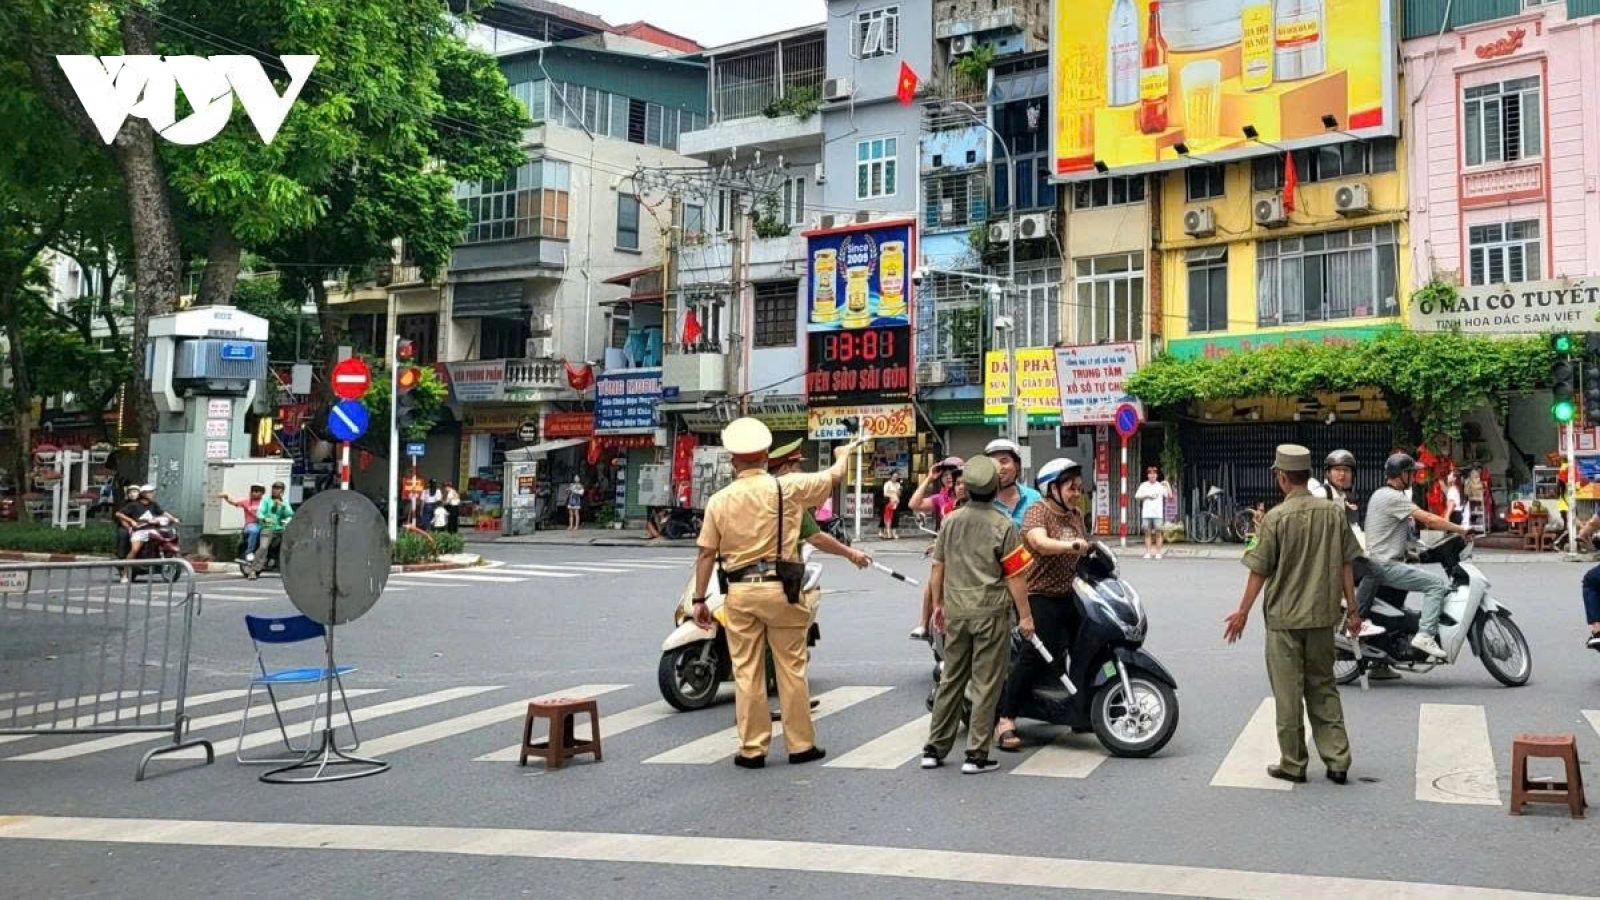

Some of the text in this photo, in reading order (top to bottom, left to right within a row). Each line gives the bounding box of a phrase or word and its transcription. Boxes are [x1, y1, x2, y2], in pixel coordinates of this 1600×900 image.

[847, 243, 869, 252] Since
[847, 253, 869, 264] 2009
[1440, 296, 1480, 314] MAI
[1486, 289, 1515, 310] CÔ
[1522, 281, 1600, 308] TUYẾT
[1465, 316, 1490, 327] HOA
[1072, 364, 1121, 379] TRUNG TÂM
[863, 411, 908, 436] 20%
